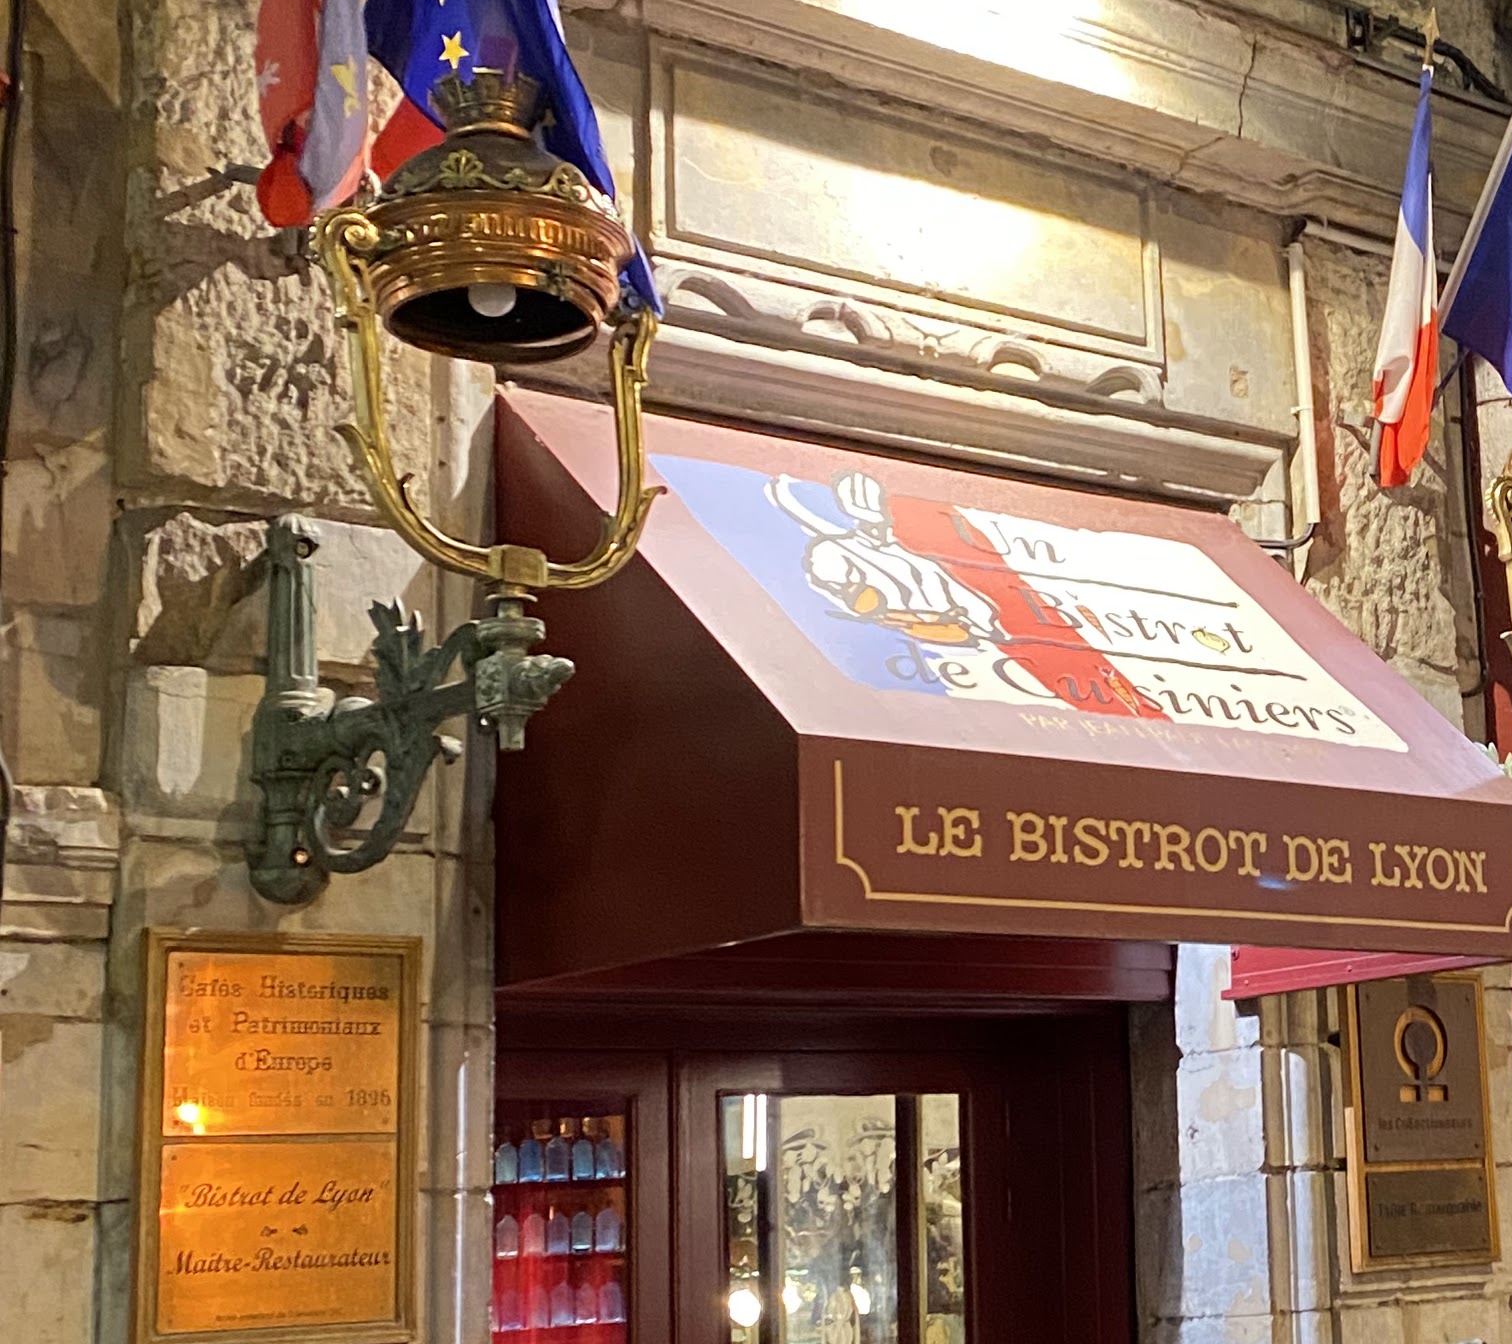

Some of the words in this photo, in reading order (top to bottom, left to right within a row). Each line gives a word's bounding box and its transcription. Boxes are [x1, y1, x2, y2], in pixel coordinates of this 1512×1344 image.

[943, 511, 1066, 566] Un
[886, 639, 977, 690] de
[894, 806, 983, 857] LE
[1006, 811, 1268, 877] BISTROT
[1281, 833, 1353, 884] DE
[1368, 841, 1488, 894] LYON
[179, 974, 244, 998] Cafés
[258, 974, 390, 1004] Historiques
[188, 1017, 212, 1034] et
[232, 1011, 382, 1036] Patrimoniaux
[234, 1048, 333, 1075] d'Europe
[278, 1181, 308, 1206] de
